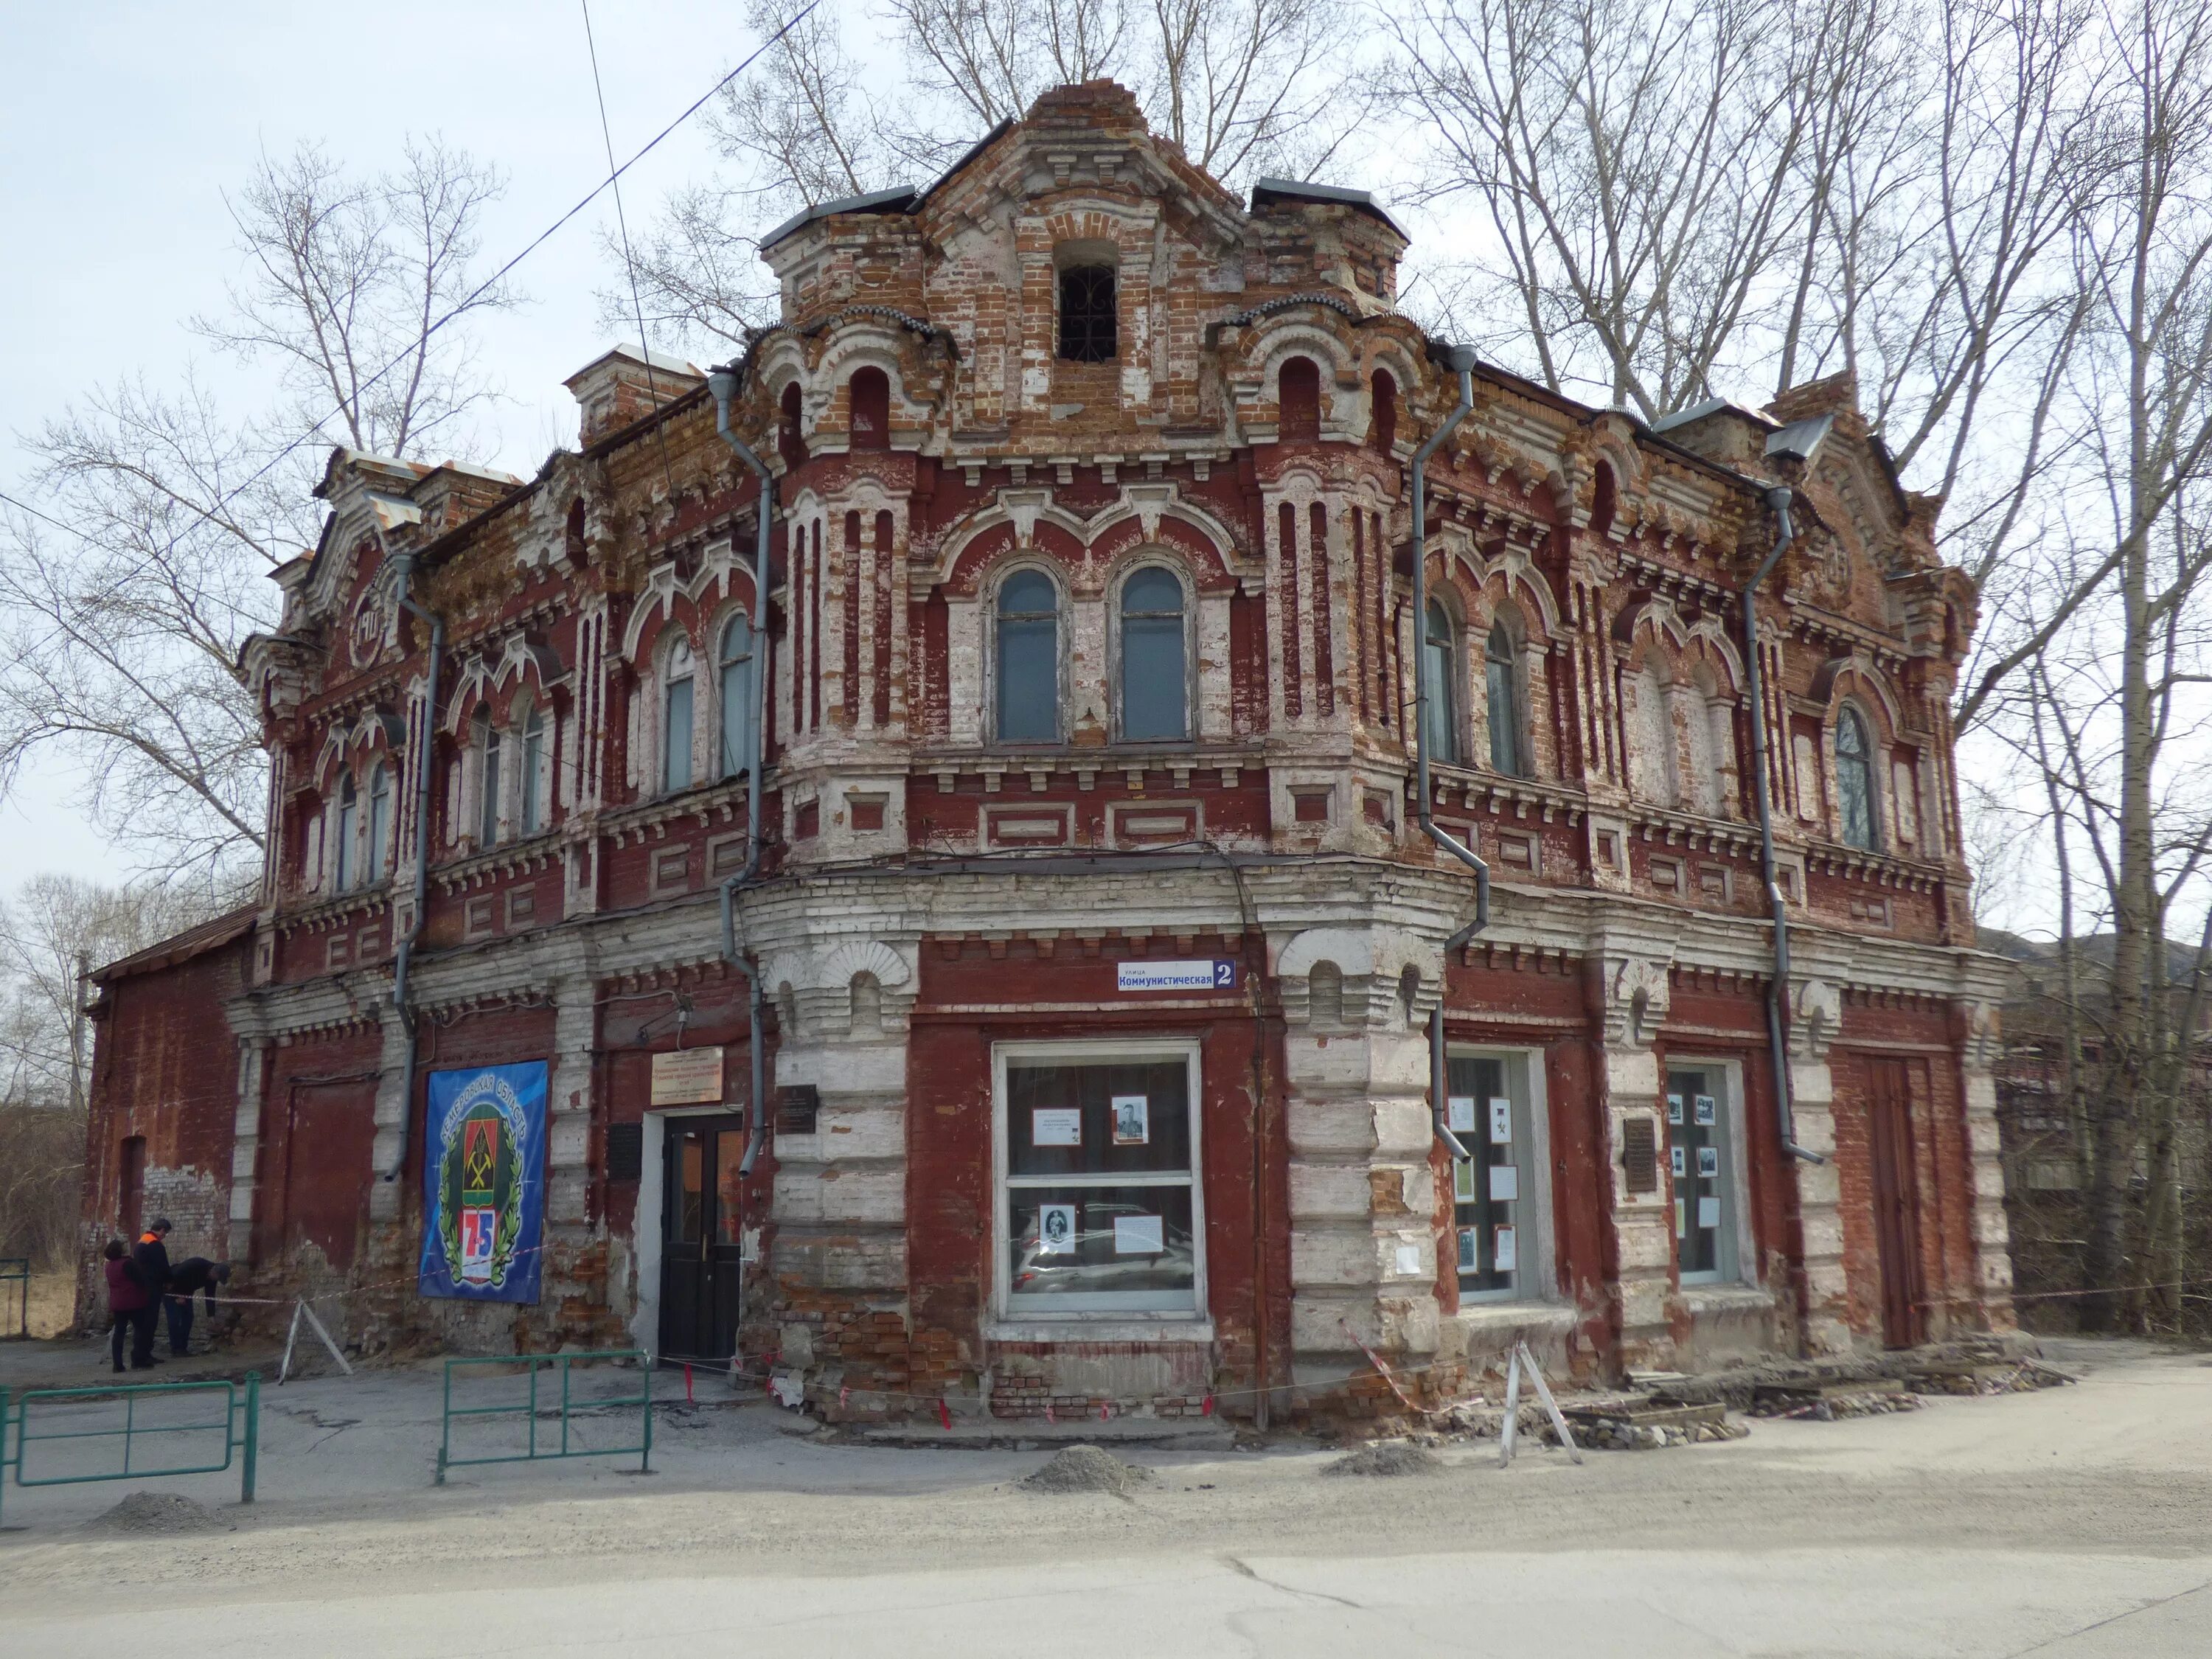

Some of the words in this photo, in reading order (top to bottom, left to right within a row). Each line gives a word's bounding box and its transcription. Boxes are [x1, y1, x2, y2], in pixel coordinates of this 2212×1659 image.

[1119, 975, 1212, 987] Коммунистическая
[1217, 964, 1231, 985] 2
[442, 1077, 493, 1141] КЕМЕРОВСКАЯ
[496, 1081, 525, 1137] ОБЛАСТЬ
[465, 1214, 492, 1256] 75
